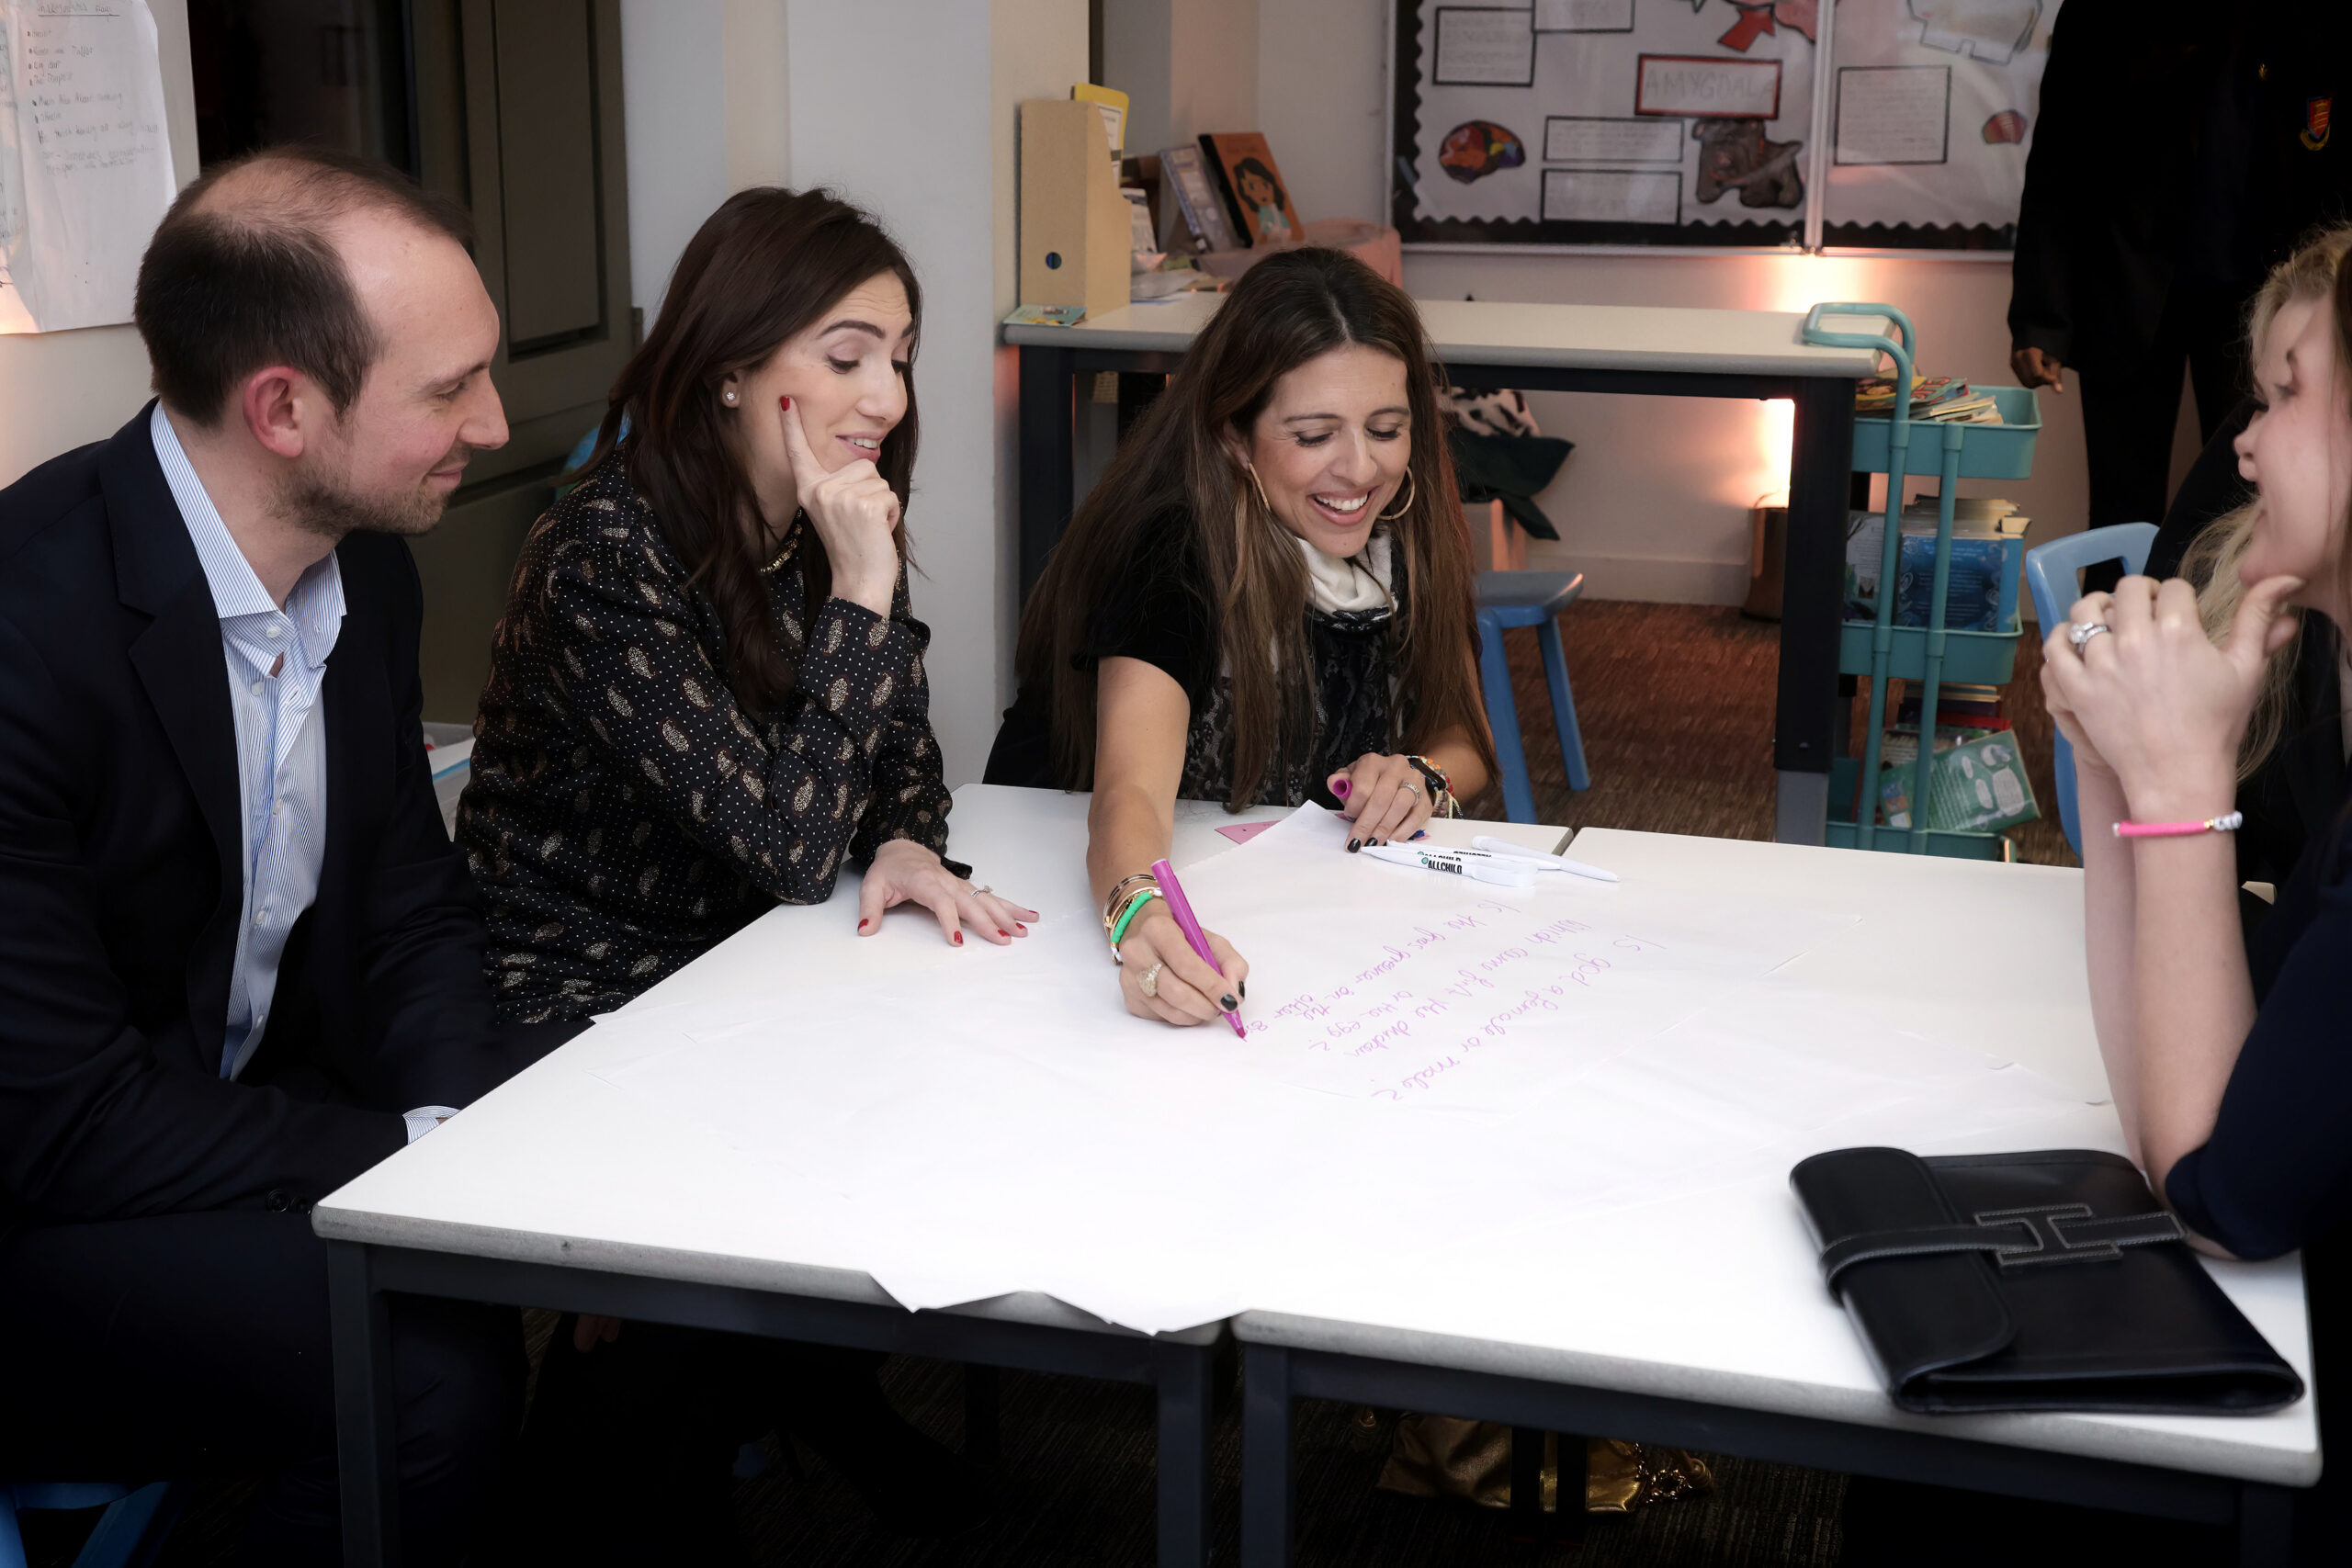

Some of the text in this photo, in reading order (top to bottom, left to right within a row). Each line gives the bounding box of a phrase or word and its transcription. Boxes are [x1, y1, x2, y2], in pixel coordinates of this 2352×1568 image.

[1644, 69, 1774, 99] AMYGDALA
[1428, 858, 1463, 874] ALLCHILD
[1476, 899, 1521, 916] Is
[1442, 913, 1487, 933] the
[1611, 935, 1667, 952] Is
[1478, 946, 1529, 980] came
[1558, 953, 1611, 987] god
[1325, 986, 1354, 999] on
[1390, 990, 1413, 1007] or
[1540, 985, 1565, 998] a
[1272, 993, 1314, 1019] other
[1297, 1001, 1330, 1021] the
[1359, 1001, 1396, 1021] the
[1409, 994, 1448, 1020] the
[1479, 990, 1558, 1036] female
[1461, 1036, 1480, 1052] or
